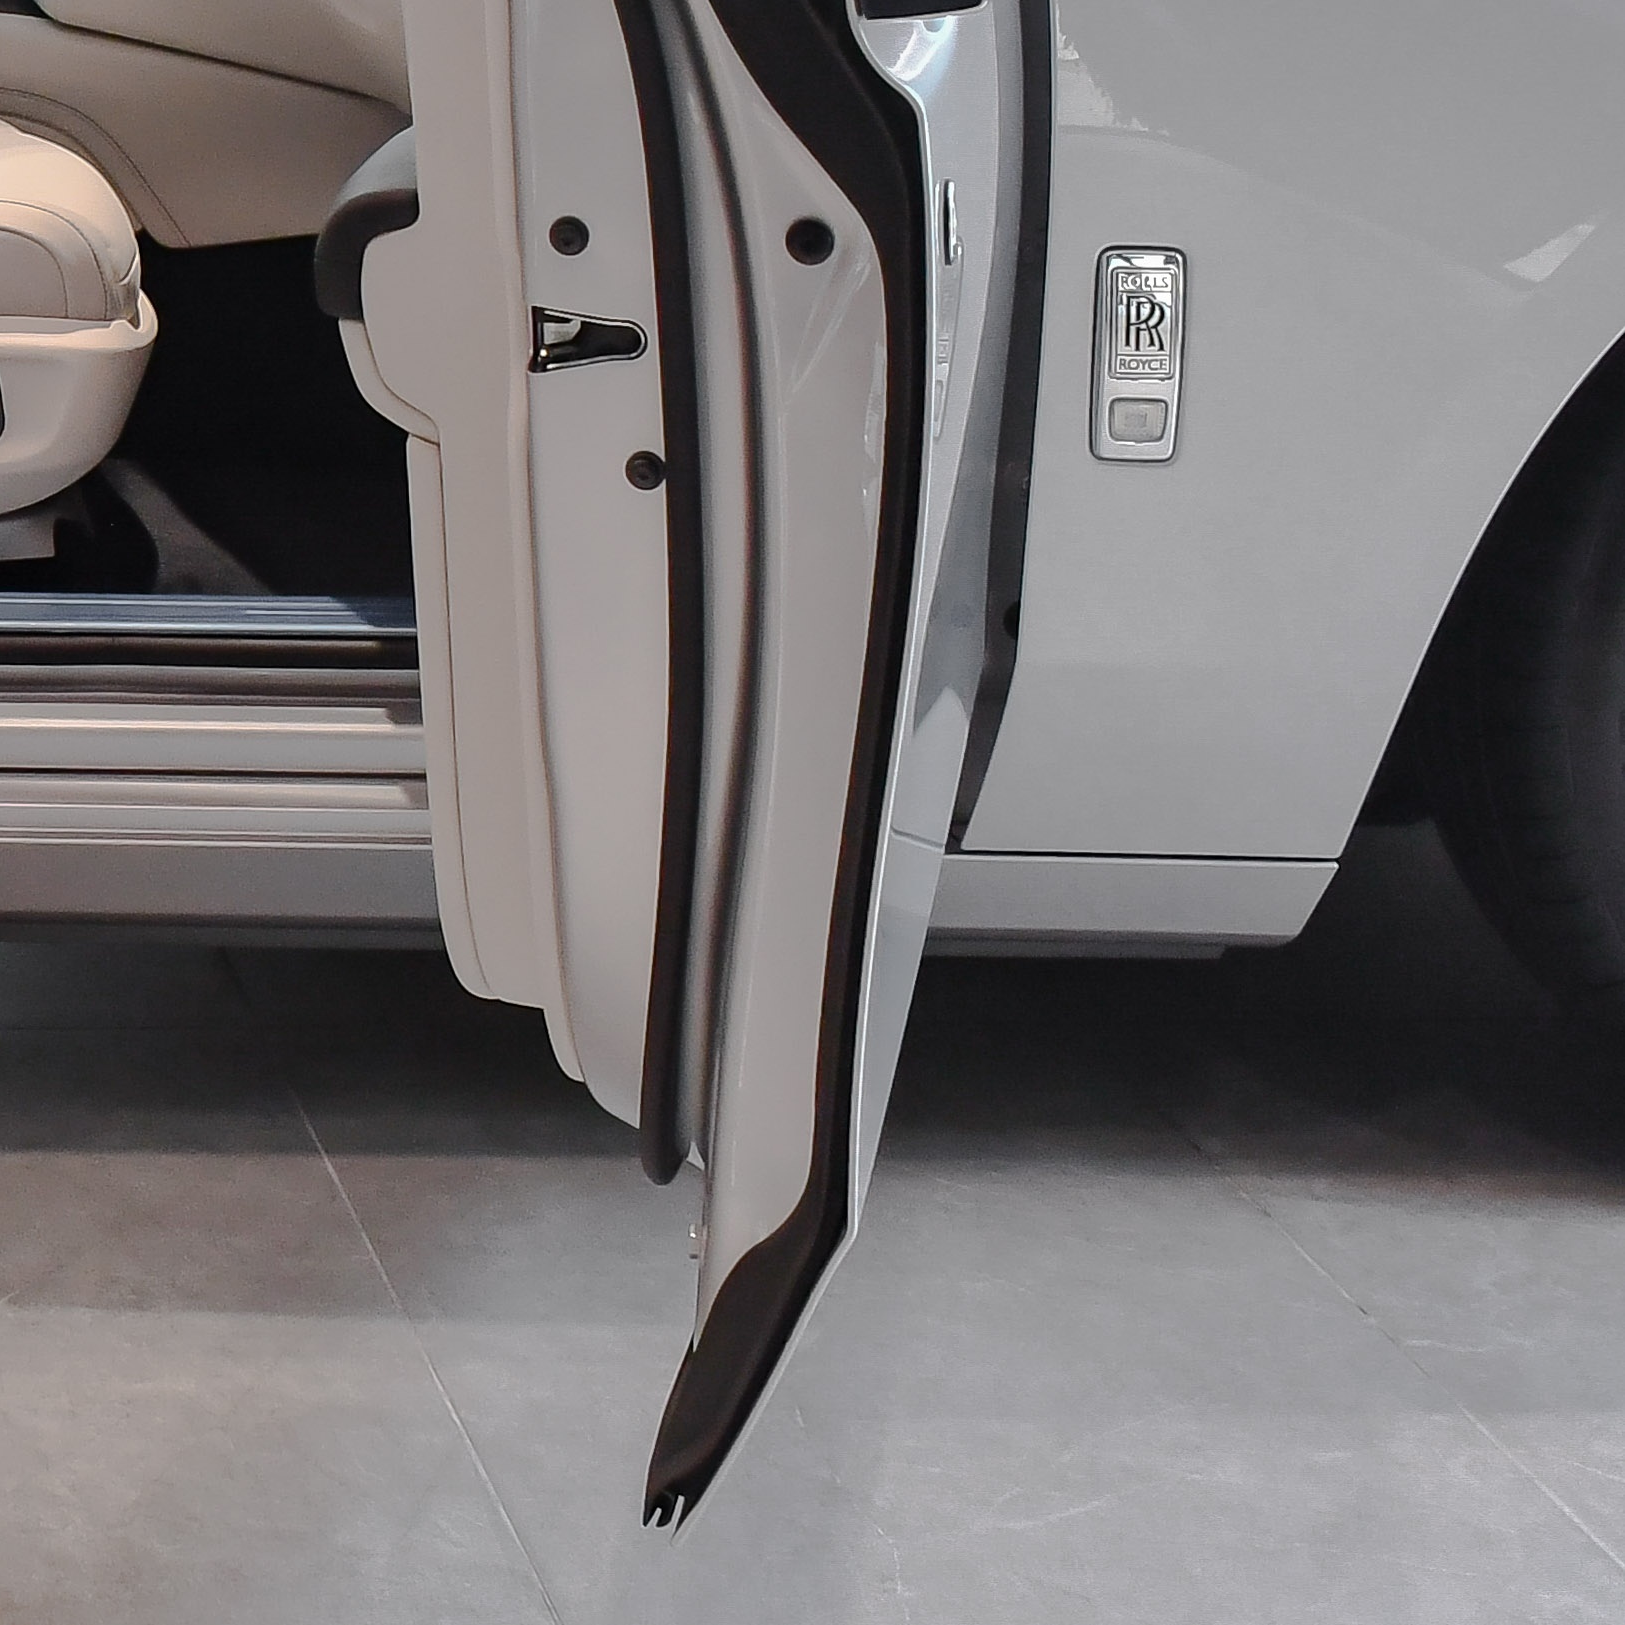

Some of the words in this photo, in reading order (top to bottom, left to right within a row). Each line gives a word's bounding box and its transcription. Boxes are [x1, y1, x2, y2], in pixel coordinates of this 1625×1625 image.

[1120, 275, 1169, 290] ROLLS
[1124, 295, 1166, 352] RR
[1118, 358, 1168, 371] ROYCE
